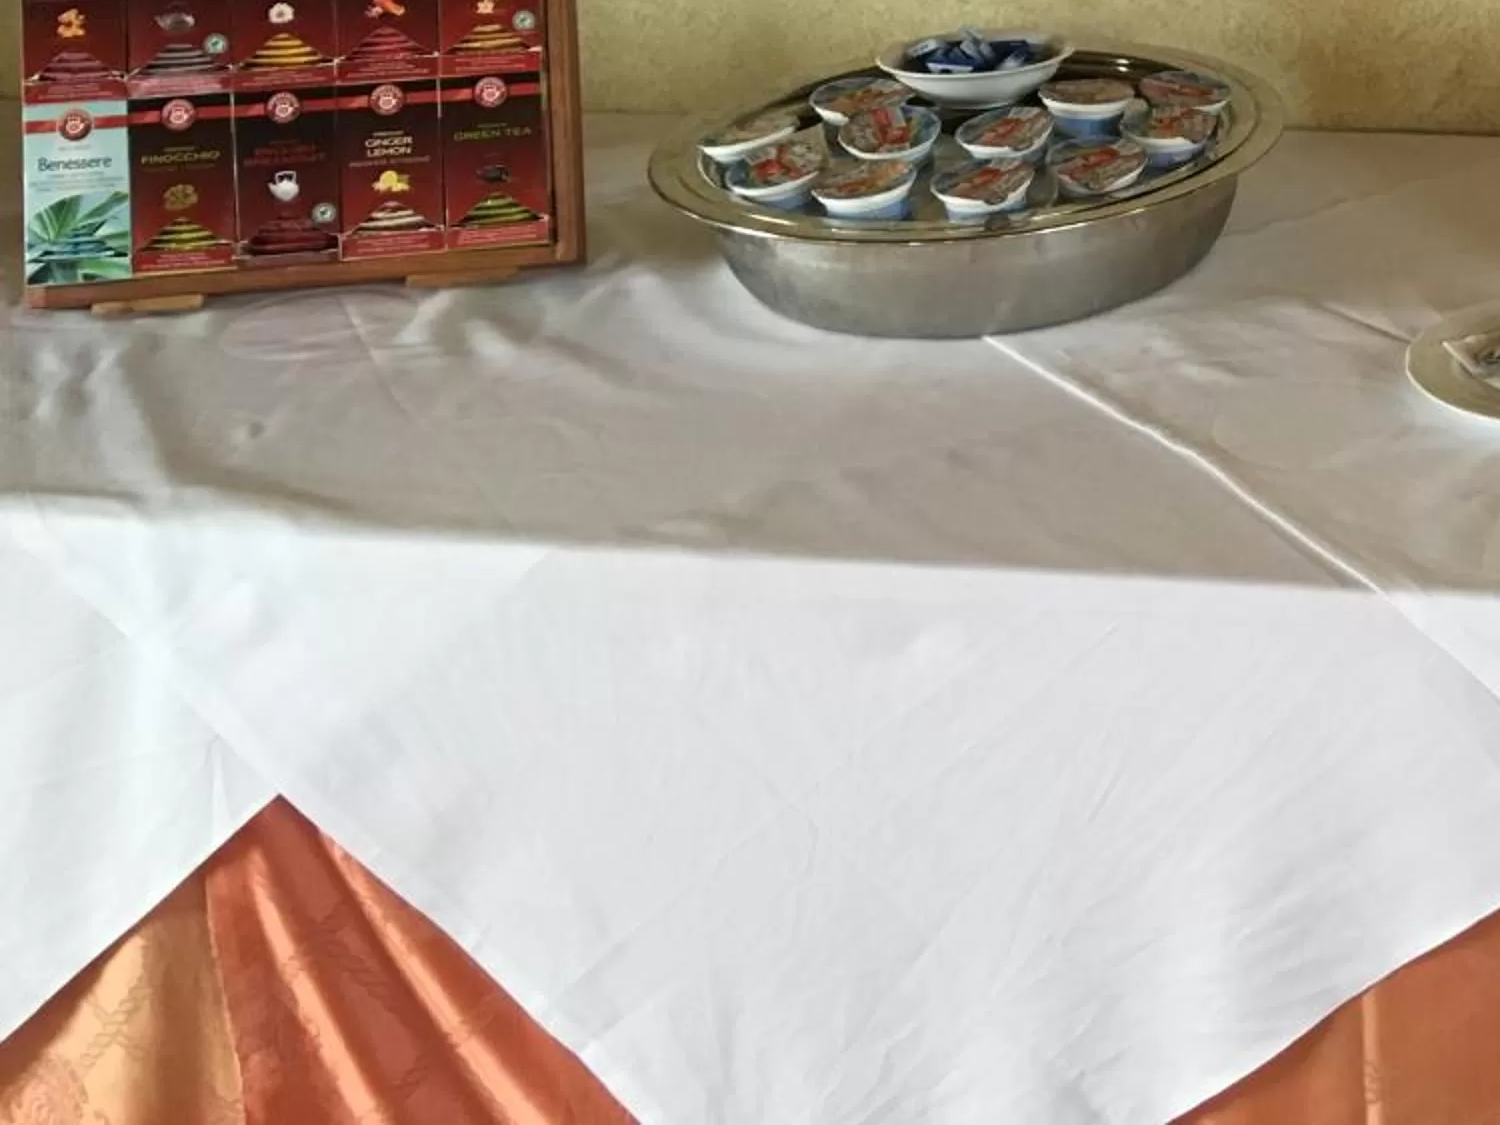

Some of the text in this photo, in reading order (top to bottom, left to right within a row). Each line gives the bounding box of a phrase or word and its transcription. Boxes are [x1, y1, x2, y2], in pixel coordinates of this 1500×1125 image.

[364, 136, 413, 148] GINGER
[140, 150, 221, 166] FINOCCHIO
[366, 146, 412, 158] LEMON
[37, 156, 113, 173] Benessere
